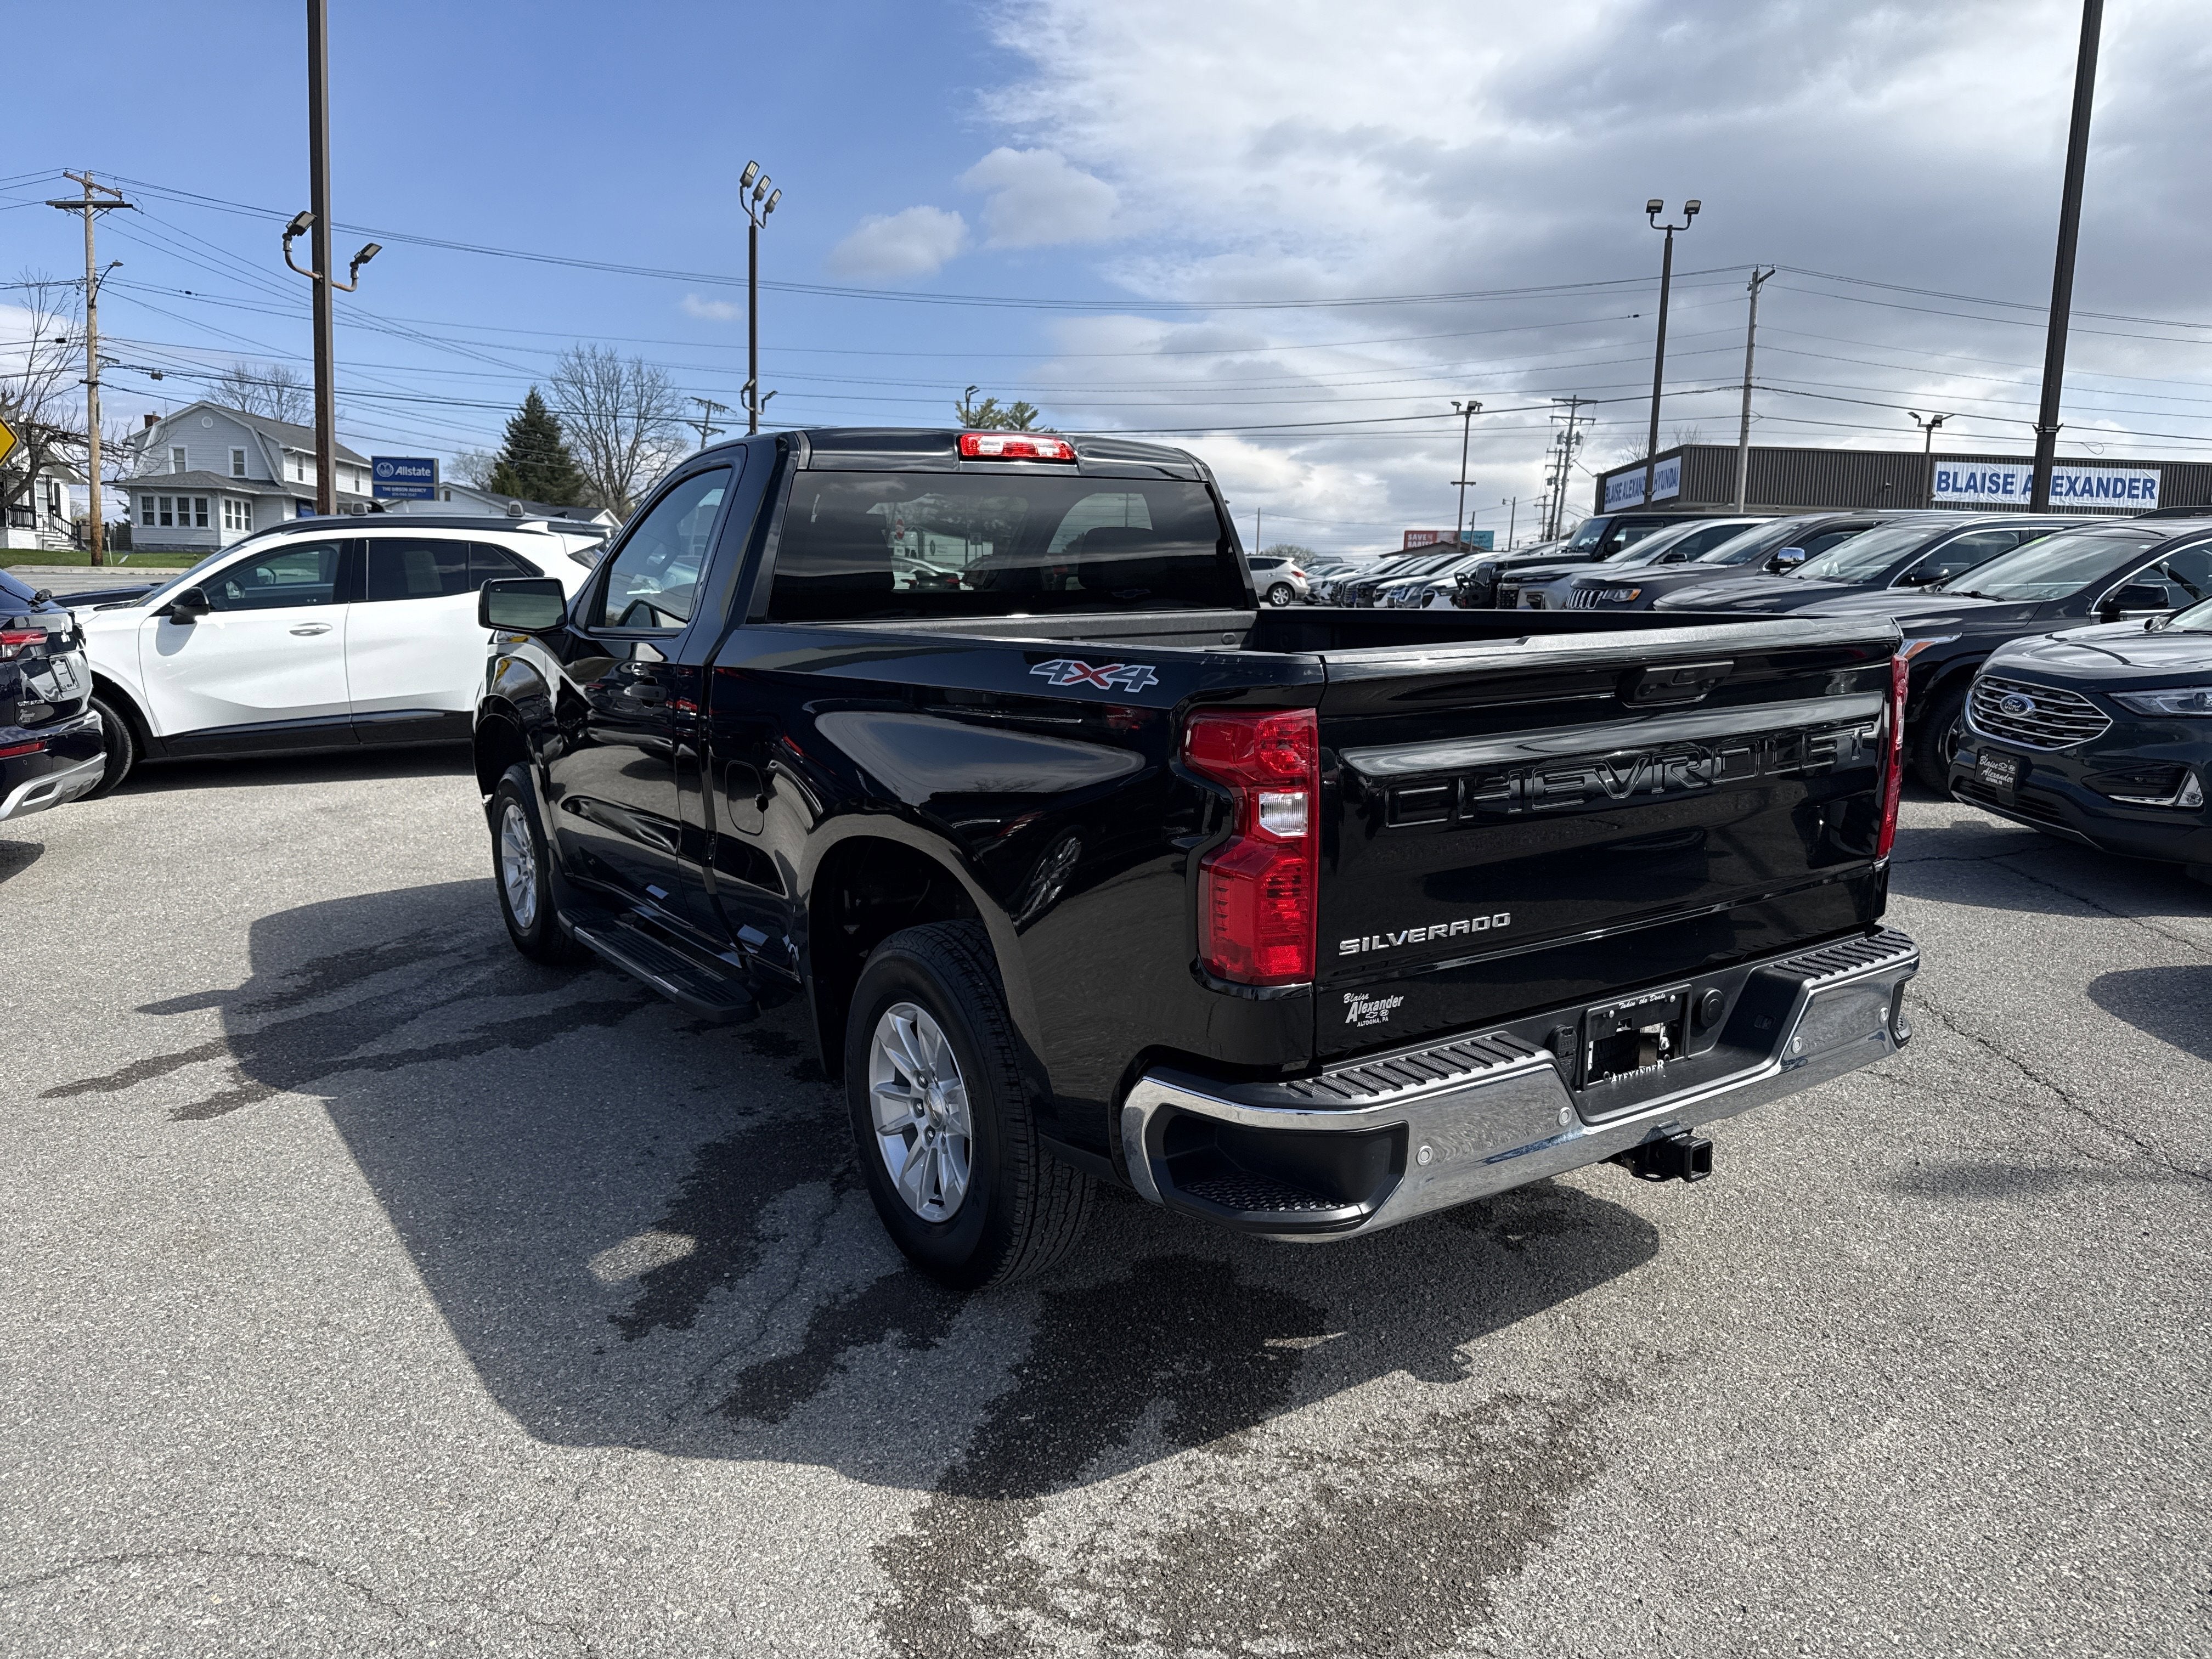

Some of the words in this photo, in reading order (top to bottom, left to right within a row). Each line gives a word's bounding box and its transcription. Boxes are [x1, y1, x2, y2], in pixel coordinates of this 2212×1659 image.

[395, 466, 431, 477] Allstate
[1605, 482, 1622, 505] BLAISE
[1622, 475, 1646, 501] ALEXAN
[1654, 466, 1679, 493] HYUNDAI
[1936, 471, 2015, 495] BLAISE
[2021, 475, 2156, 500] AEXANDER
[2004, 698, 2022, 712] Ford
[1979, 755, 1999, 769] Blaise
[1385, 722, 1875, 829] CHEVROLET
[1980, 767, 2013, 783] Alexander
[1339, 912, 1511, 956] SILVERADO
[1344, 992, 1369, 1003] Blaise
[1639, 997, 1647, 1005] the
[1649, 992, 1666, 1002] Deals
[1345, 995, 1404, 1024] Alexander
[1357, 1018, 1381, 1028] ALTOONA,
